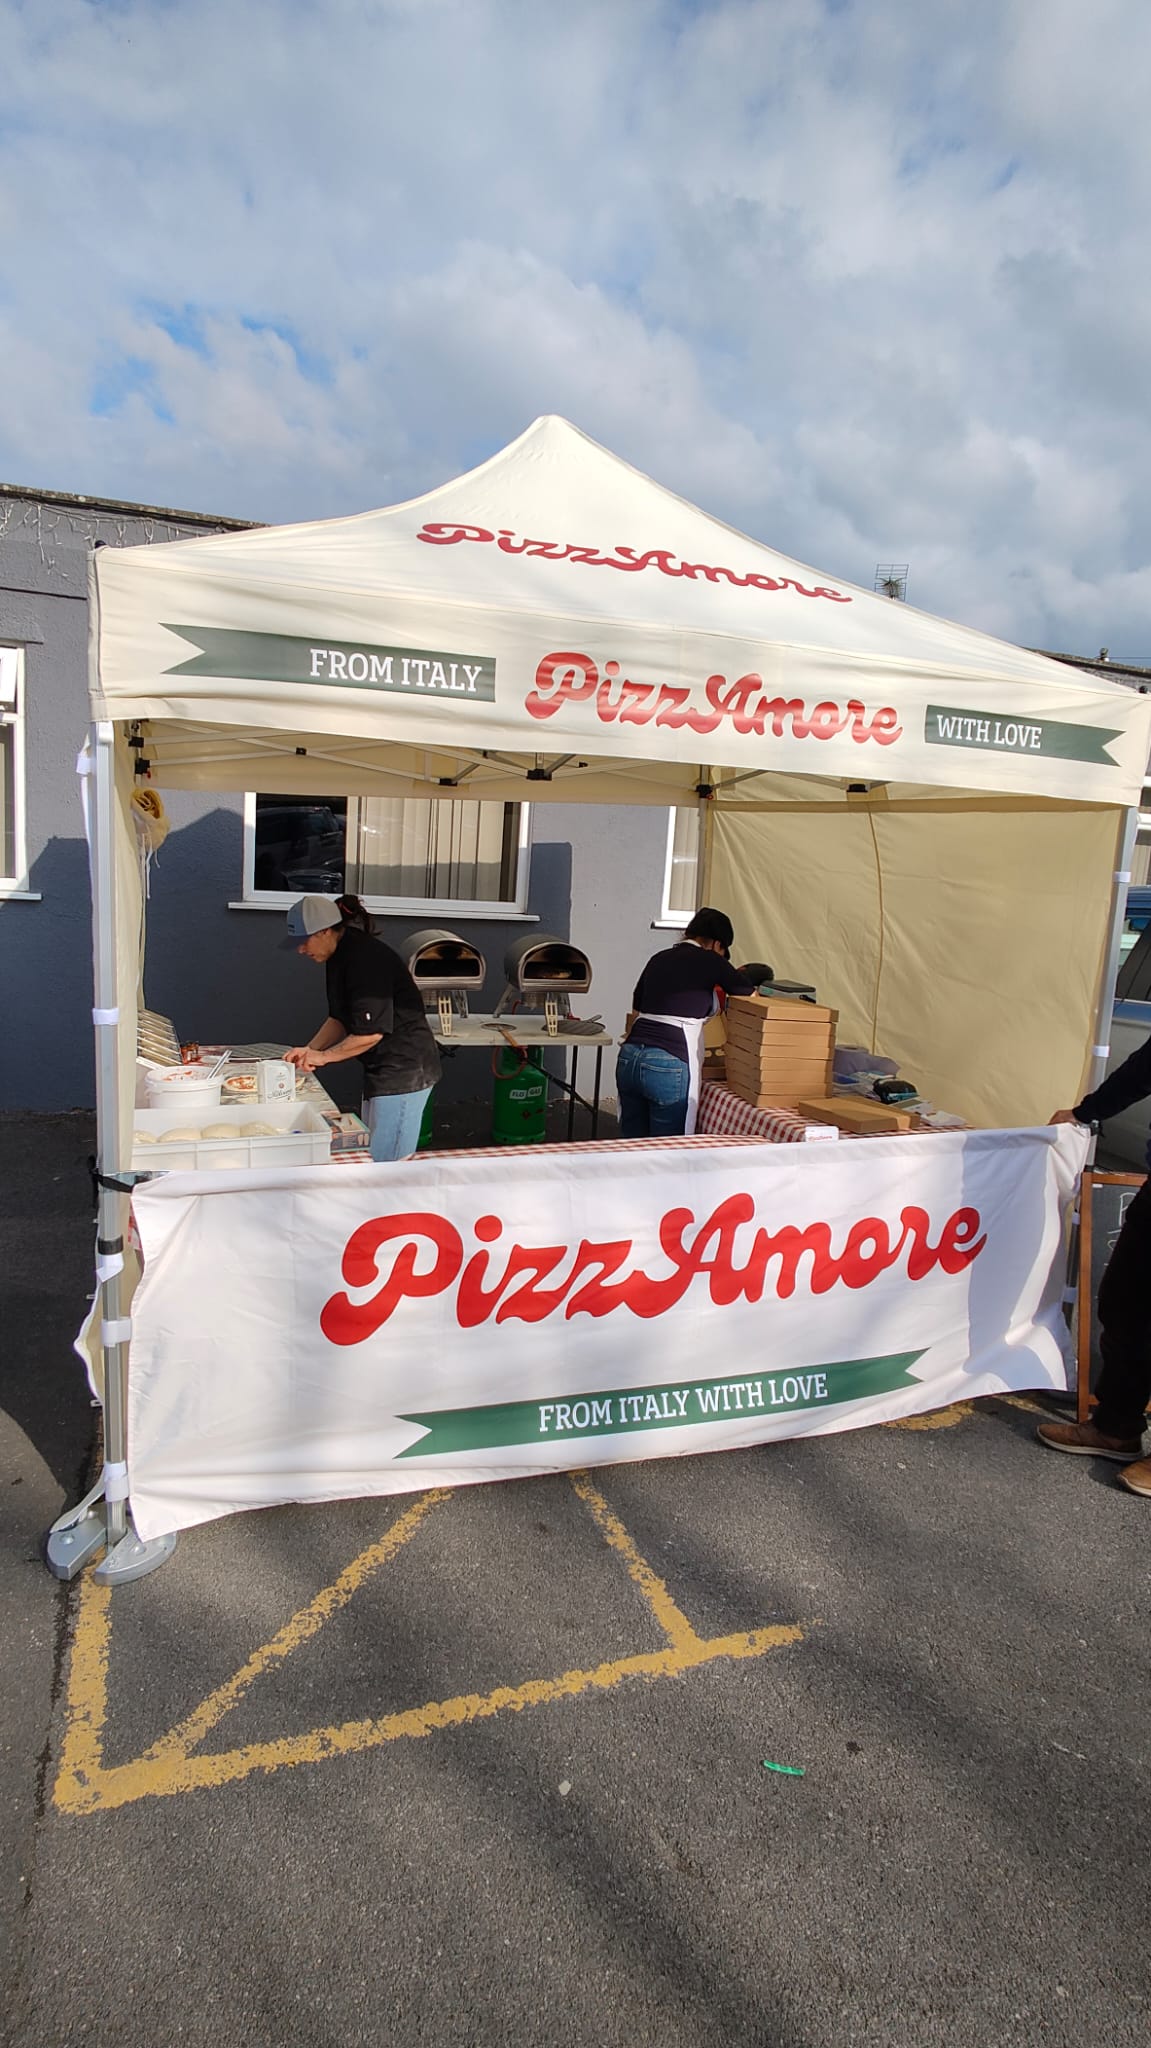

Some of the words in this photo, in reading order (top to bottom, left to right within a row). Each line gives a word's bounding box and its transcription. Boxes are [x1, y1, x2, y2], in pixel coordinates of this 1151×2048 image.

[417, 523, 852, 603] PizzAmore
[310, 648, 394, 684] FROM
[401, 658, 482, 692] ITALY
[526, 651, 902, 746] PizzAmore
[937, 714, 990, 743] WITH
[994, 722, 1042, 750] LOVE
[320, 1193, 987, 1346] PizzAmore
[539, 1399, 611, 1432] FROM
[619, 1389, 690, 1423] ITALY
[695, 1381, 764, 1413] WITH
[768, 1373, 828, 1406] LOVE
